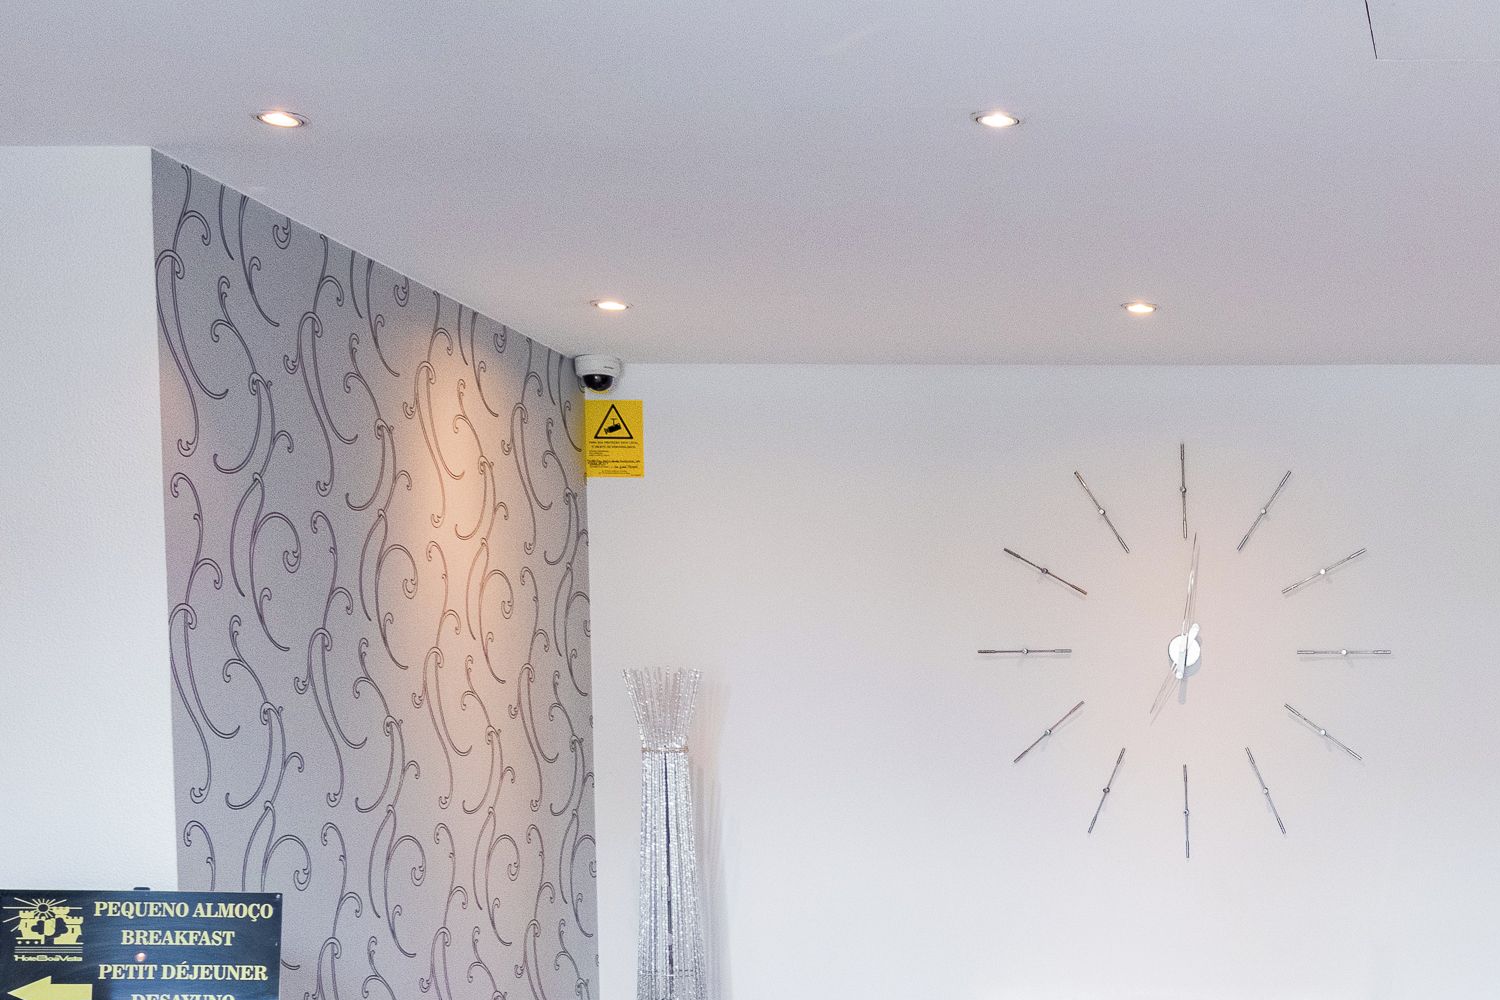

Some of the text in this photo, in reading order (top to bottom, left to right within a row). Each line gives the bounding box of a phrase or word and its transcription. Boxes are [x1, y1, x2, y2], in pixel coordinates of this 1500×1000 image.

[93, 901, 274, 922] PEQUENO ALMOÇO
[121, 930, 236, 946] BREAKFAST
[98, 961, 269, 981] PETIT DÉJEUNER
